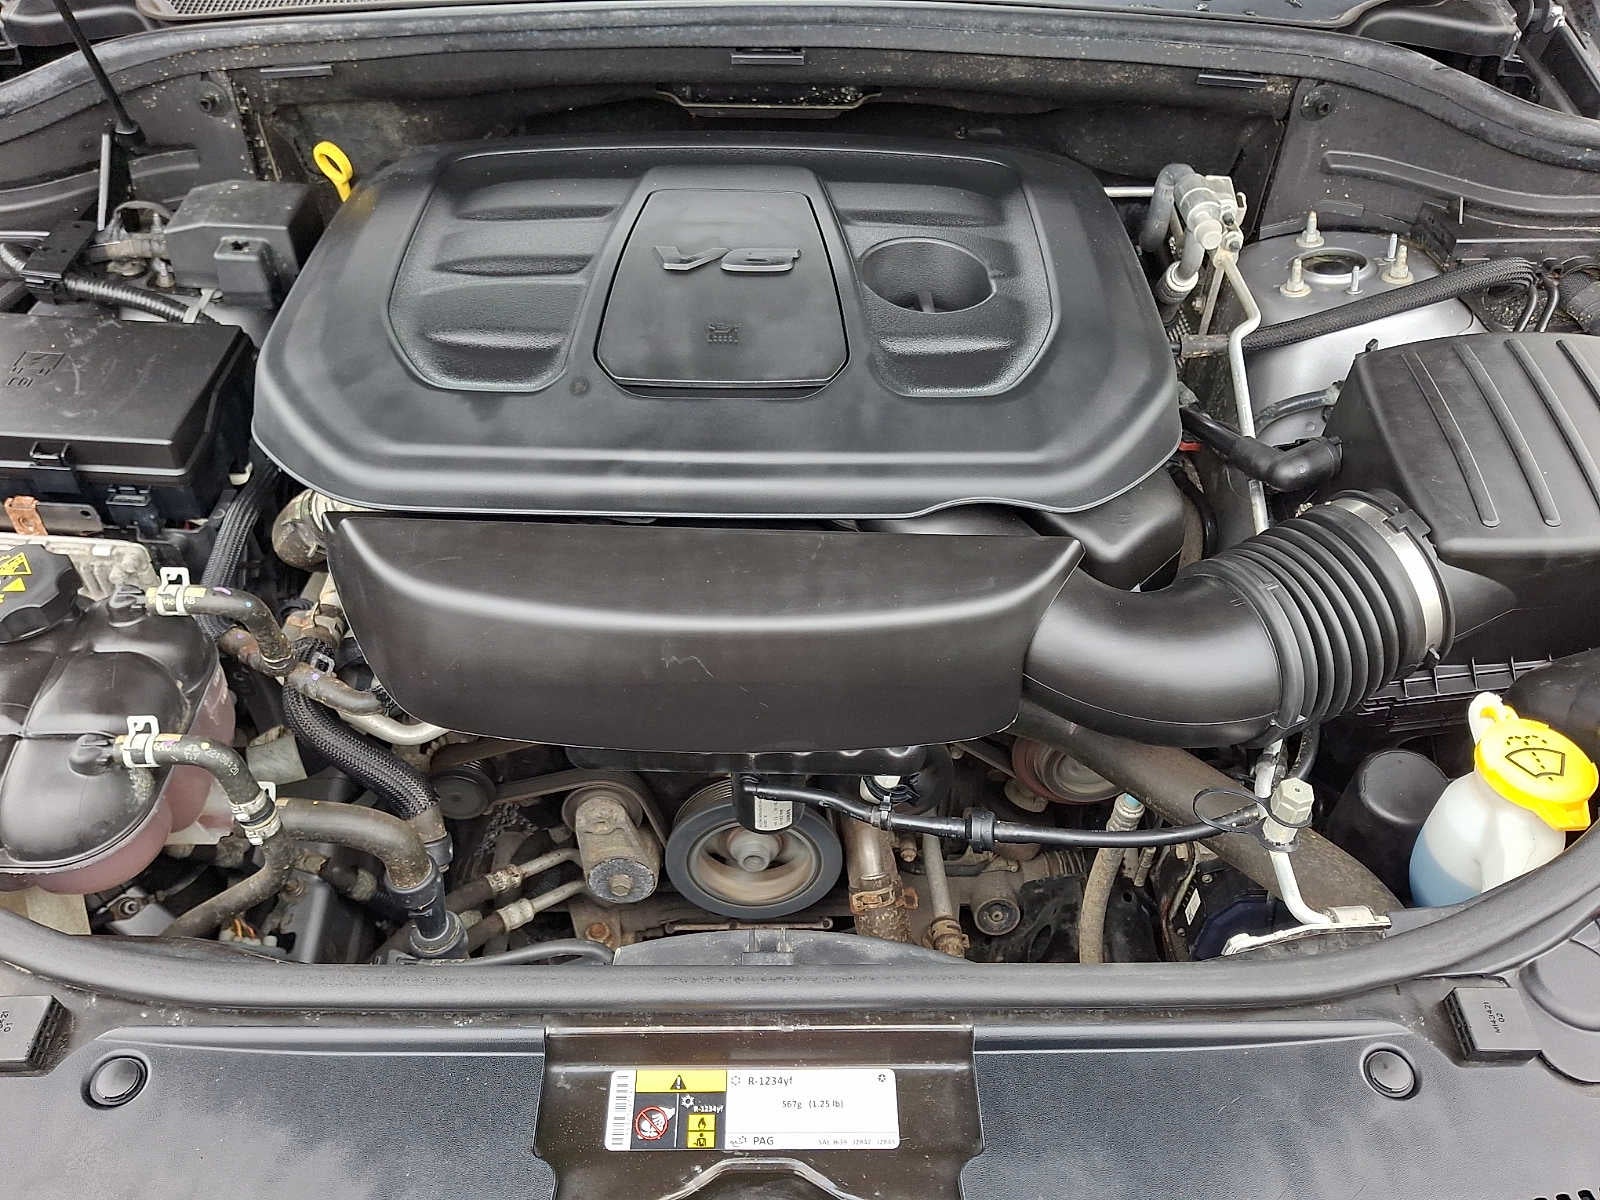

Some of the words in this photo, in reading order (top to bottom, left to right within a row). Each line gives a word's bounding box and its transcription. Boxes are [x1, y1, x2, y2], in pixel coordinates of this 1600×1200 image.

[655, 246, 801, 272] V6
[748, 1075, 793, 1088] R-1234yf
[693, 1104, 725, 1114] R-1234yf
[782, 1099, 803, 1110] 567g
[808, 1098, 830, 1109] (1.25
[832, 1098, 844, 1109] lb)
[753, 1136, 774, 1145] PAG
